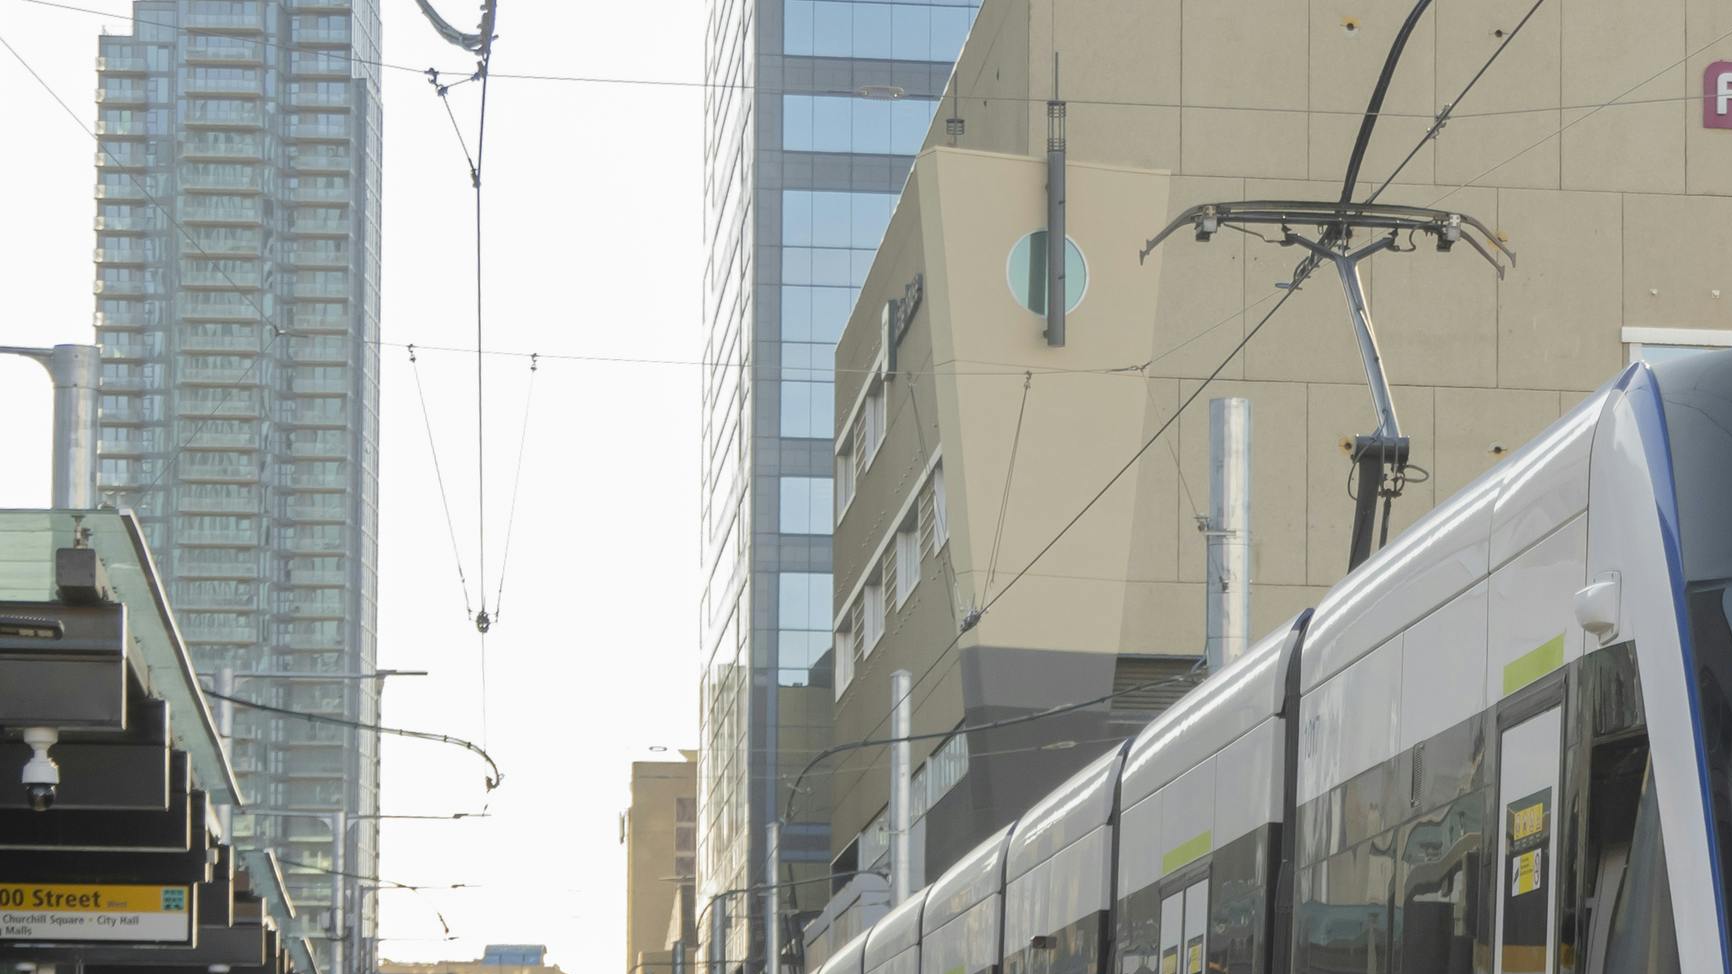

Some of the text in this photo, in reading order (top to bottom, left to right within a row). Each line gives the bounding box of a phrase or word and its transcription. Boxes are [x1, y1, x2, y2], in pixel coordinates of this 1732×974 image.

[32, 888, 102, 908] Street
[2, 914, 140, 927] Churchill Square City Hall
[5, 926, 32, 936] Malls
